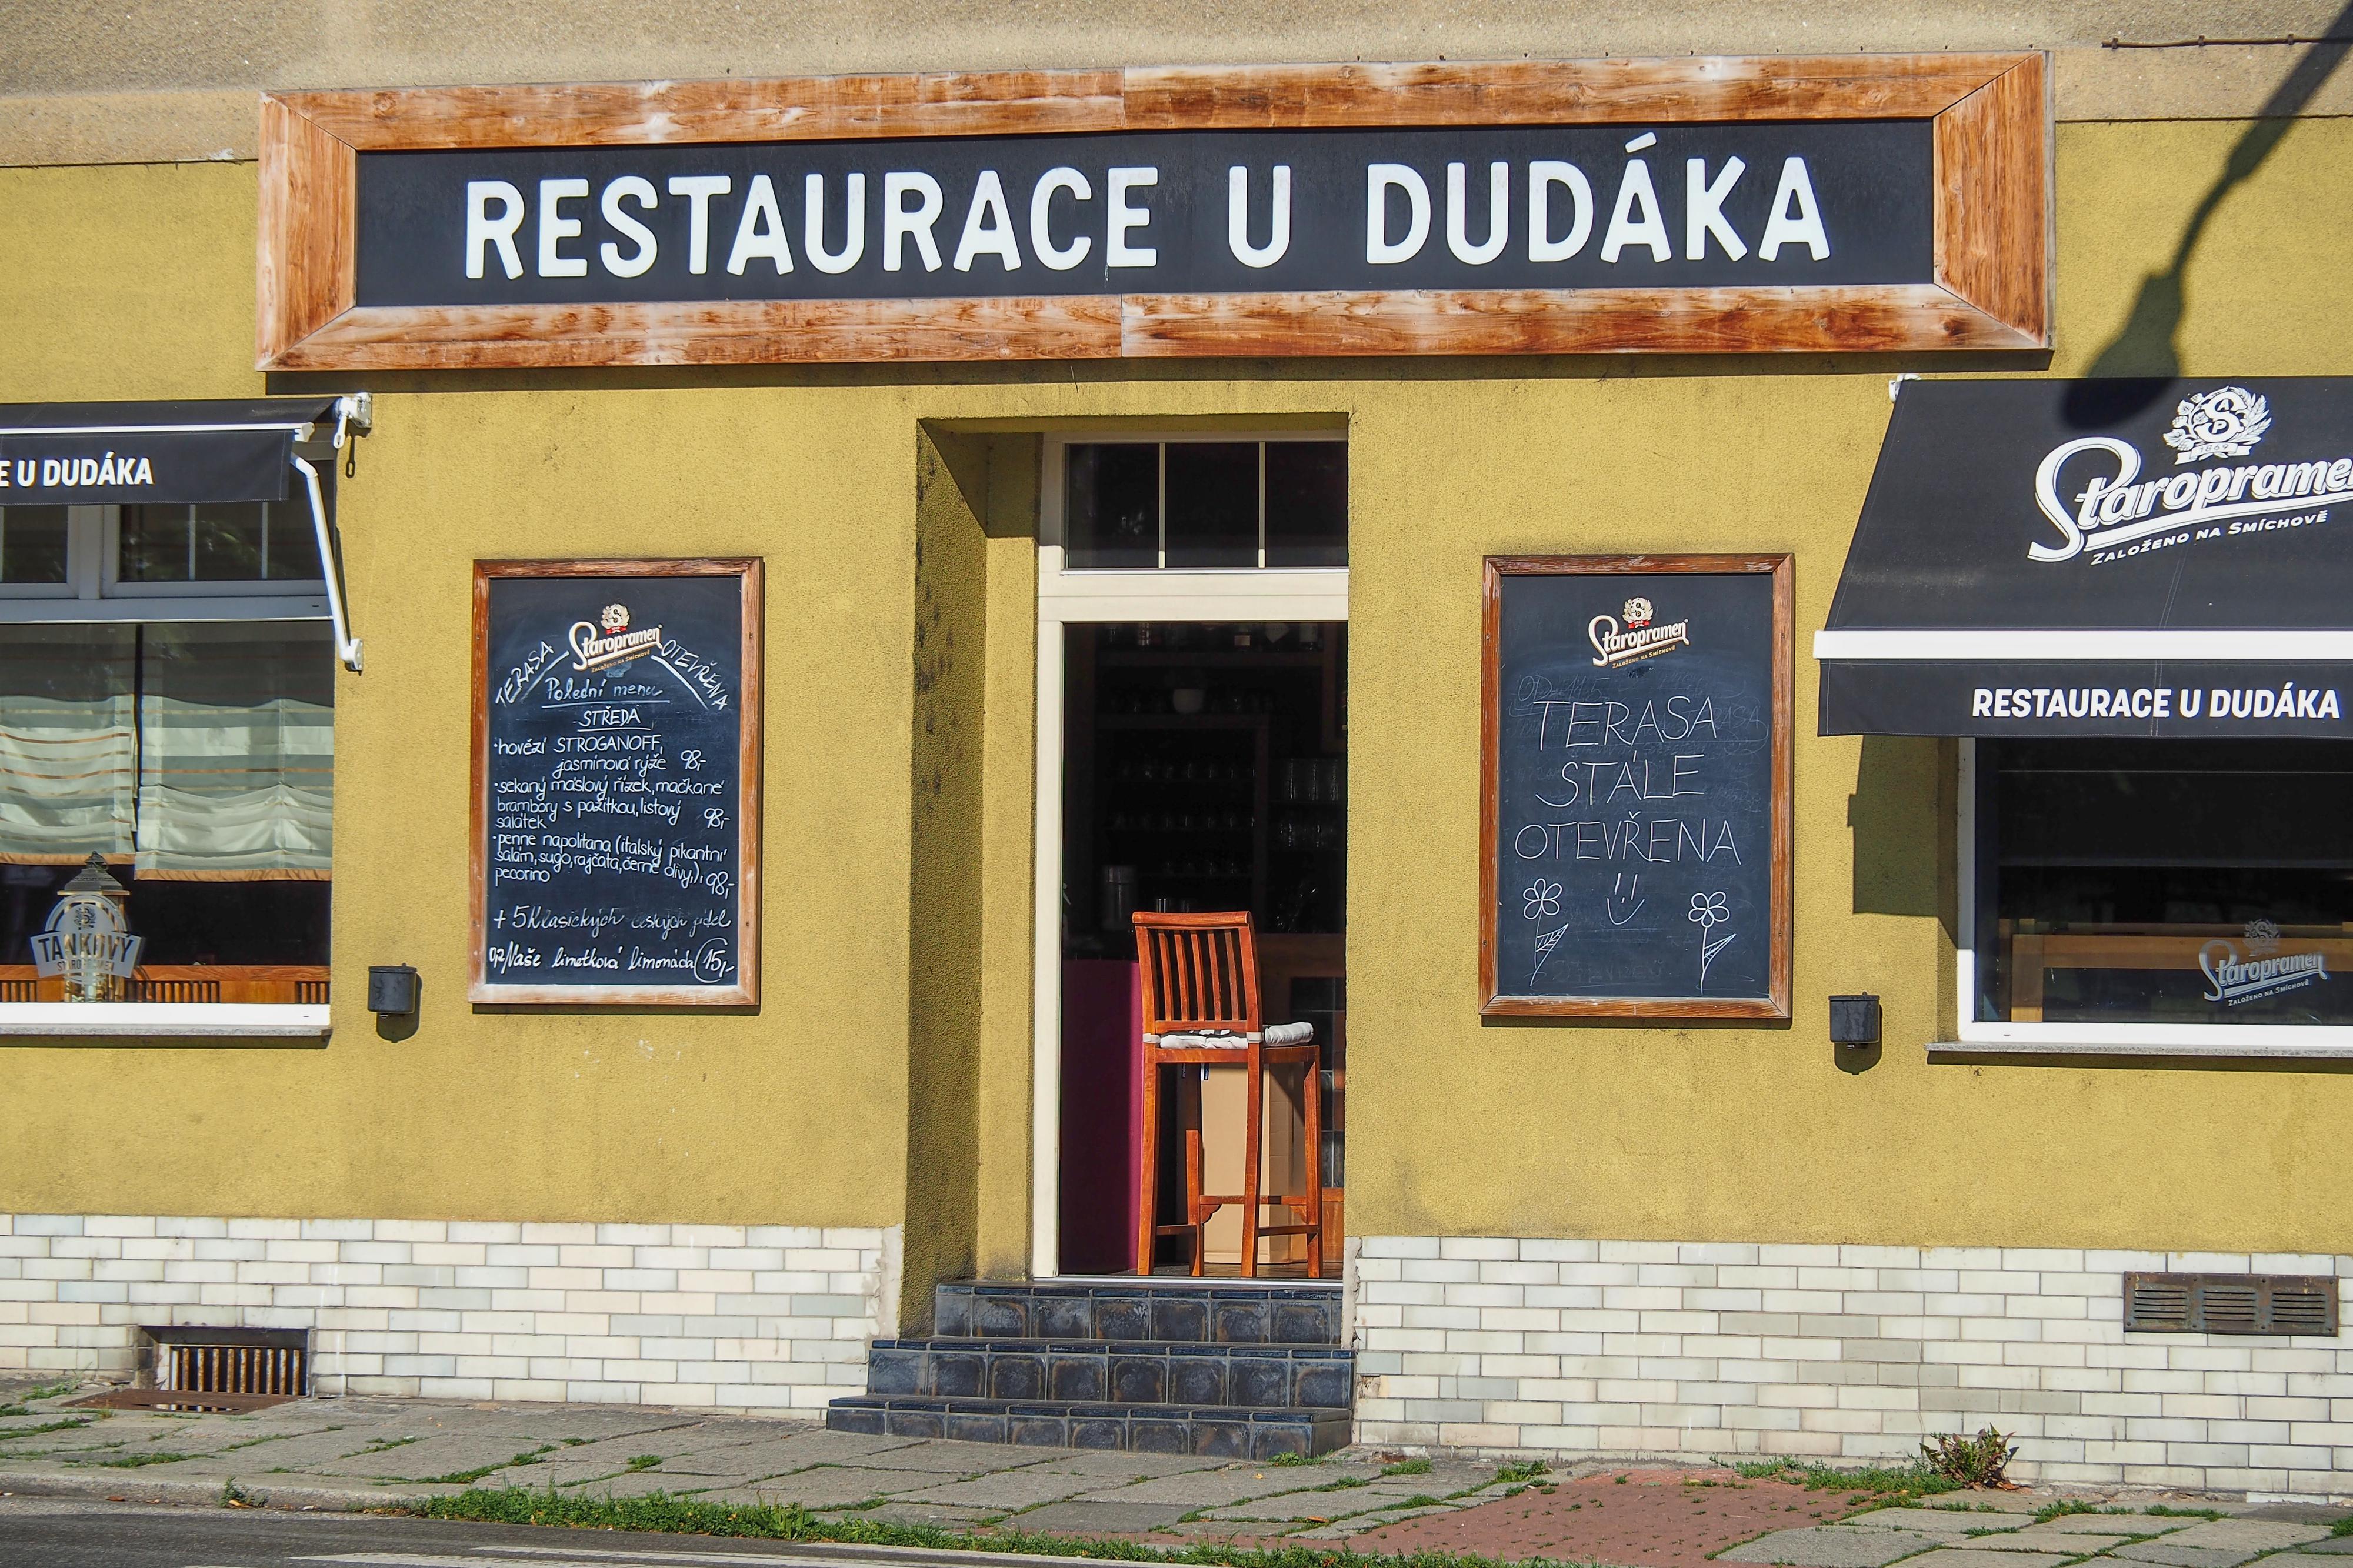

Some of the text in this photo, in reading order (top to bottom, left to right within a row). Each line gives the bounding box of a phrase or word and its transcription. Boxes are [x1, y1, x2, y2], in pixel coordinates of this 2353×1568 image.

[465, 131, 1831, 280] RESTAURACE U DUDÁKA
[2199, 443, 2229, 453] 1869
[16, 459, 36, 487] U
[42, 451, 154, 486] DUDÁKA
[2027, 436, 2353, 562] Staroprame
[2091, 509, 2328, 566] ZALOŽENO NA SMÍCHOVĚ
[568, 621, 664, 672] Staropramen
[1588, 615, 1690, 667] Staropramen
[495, 640, 555, 708] TERASA
[545, 676, 664, 702] Polední menu
[661, 639, 729, 711] OTEVŘENA
[576, 705, 641, 727] STŘEDA
[1972, 682, 2341, 719] RESTAURACE U DUDÁKA
[1532, 695, 1717, 751] TERASA
[498, 736, 548, 755] hovězí
[635, 753, 667, 778] rýže
[1535, 750, 1705, 808] STÁLE
[497, 775, 547, 802] sekaný
[551, 774, 609, 802] máslový
[495, 812, 548, 829] salátek
[497, 796, 558, 822] brambory
[562, 800, 574, 812] s
[498, 833, 536, 852] penne
[542, 831, 612, 854] napolitana
[669, 842, 728, 867] pikantní
[1514, 810, 1742, 866] OTEVŘENA
[495, 866, 551, 887] pecorino
[37, 931, 135, 963] TANKOVÝ
[551, 945, 624, 970] limetková
[627, 945, 695, 971] limonáda
[2198, 939, 2328, 1002] Staropramen
[2227, 994, 2263, 1007] ZALOŽENO
[2275, 978, 2310, 995] SMÍCHOVĚ
